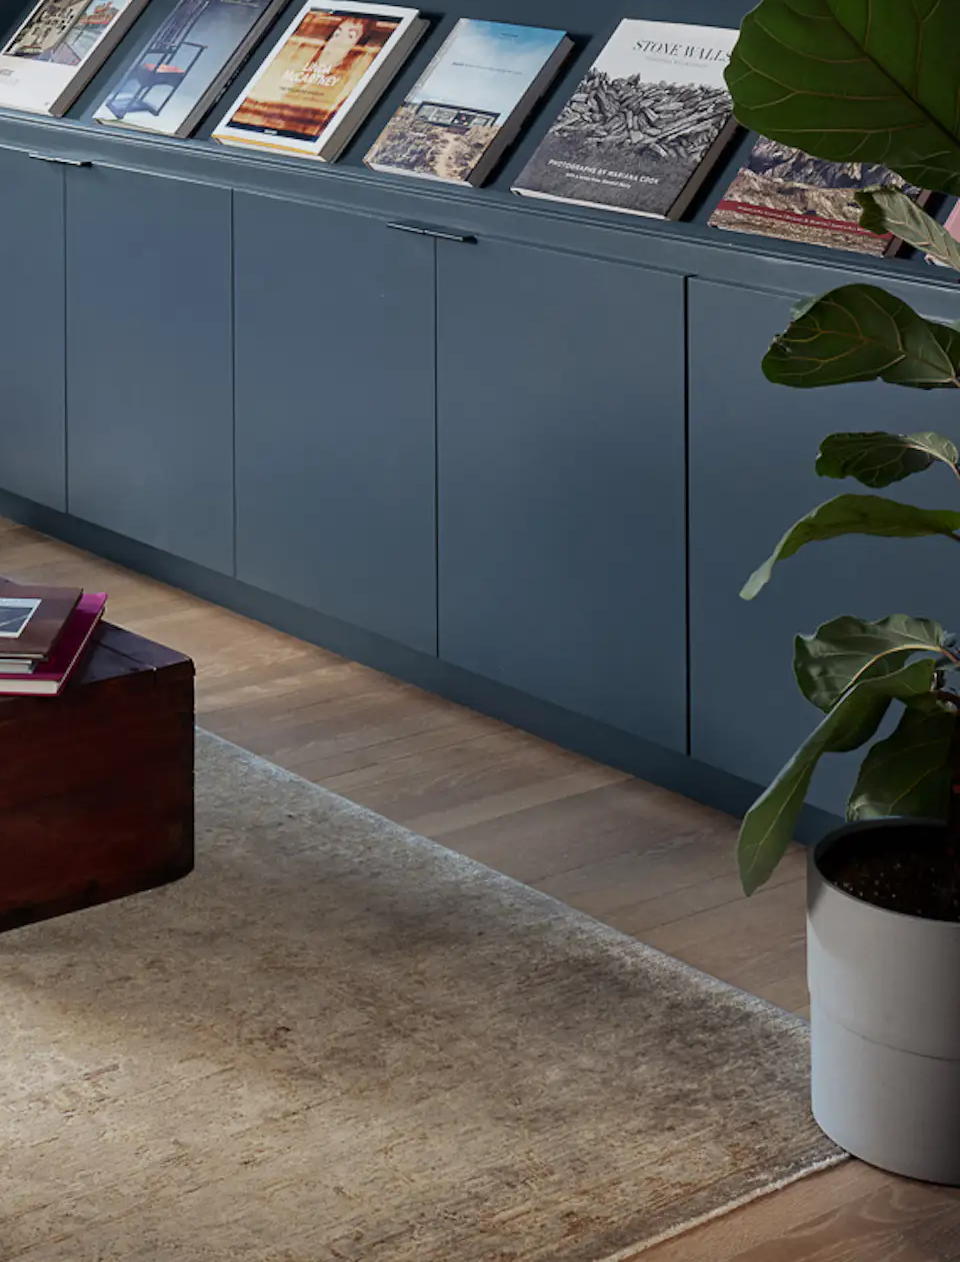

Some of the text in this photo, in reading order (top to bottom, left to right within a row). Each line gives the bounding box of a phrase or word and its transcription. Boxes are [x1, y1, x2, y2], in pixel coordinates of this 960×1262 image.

[633, 39, 682, 56] STONE
[683, 45, 731, 62] WALLS
[302, 61, 332, 74] LINDA
[548, 158, 597, 174] PHOTOGRAPHS
[607, 170, 639, 182] MARIANA
[639, 175, 659, 185] COOK
